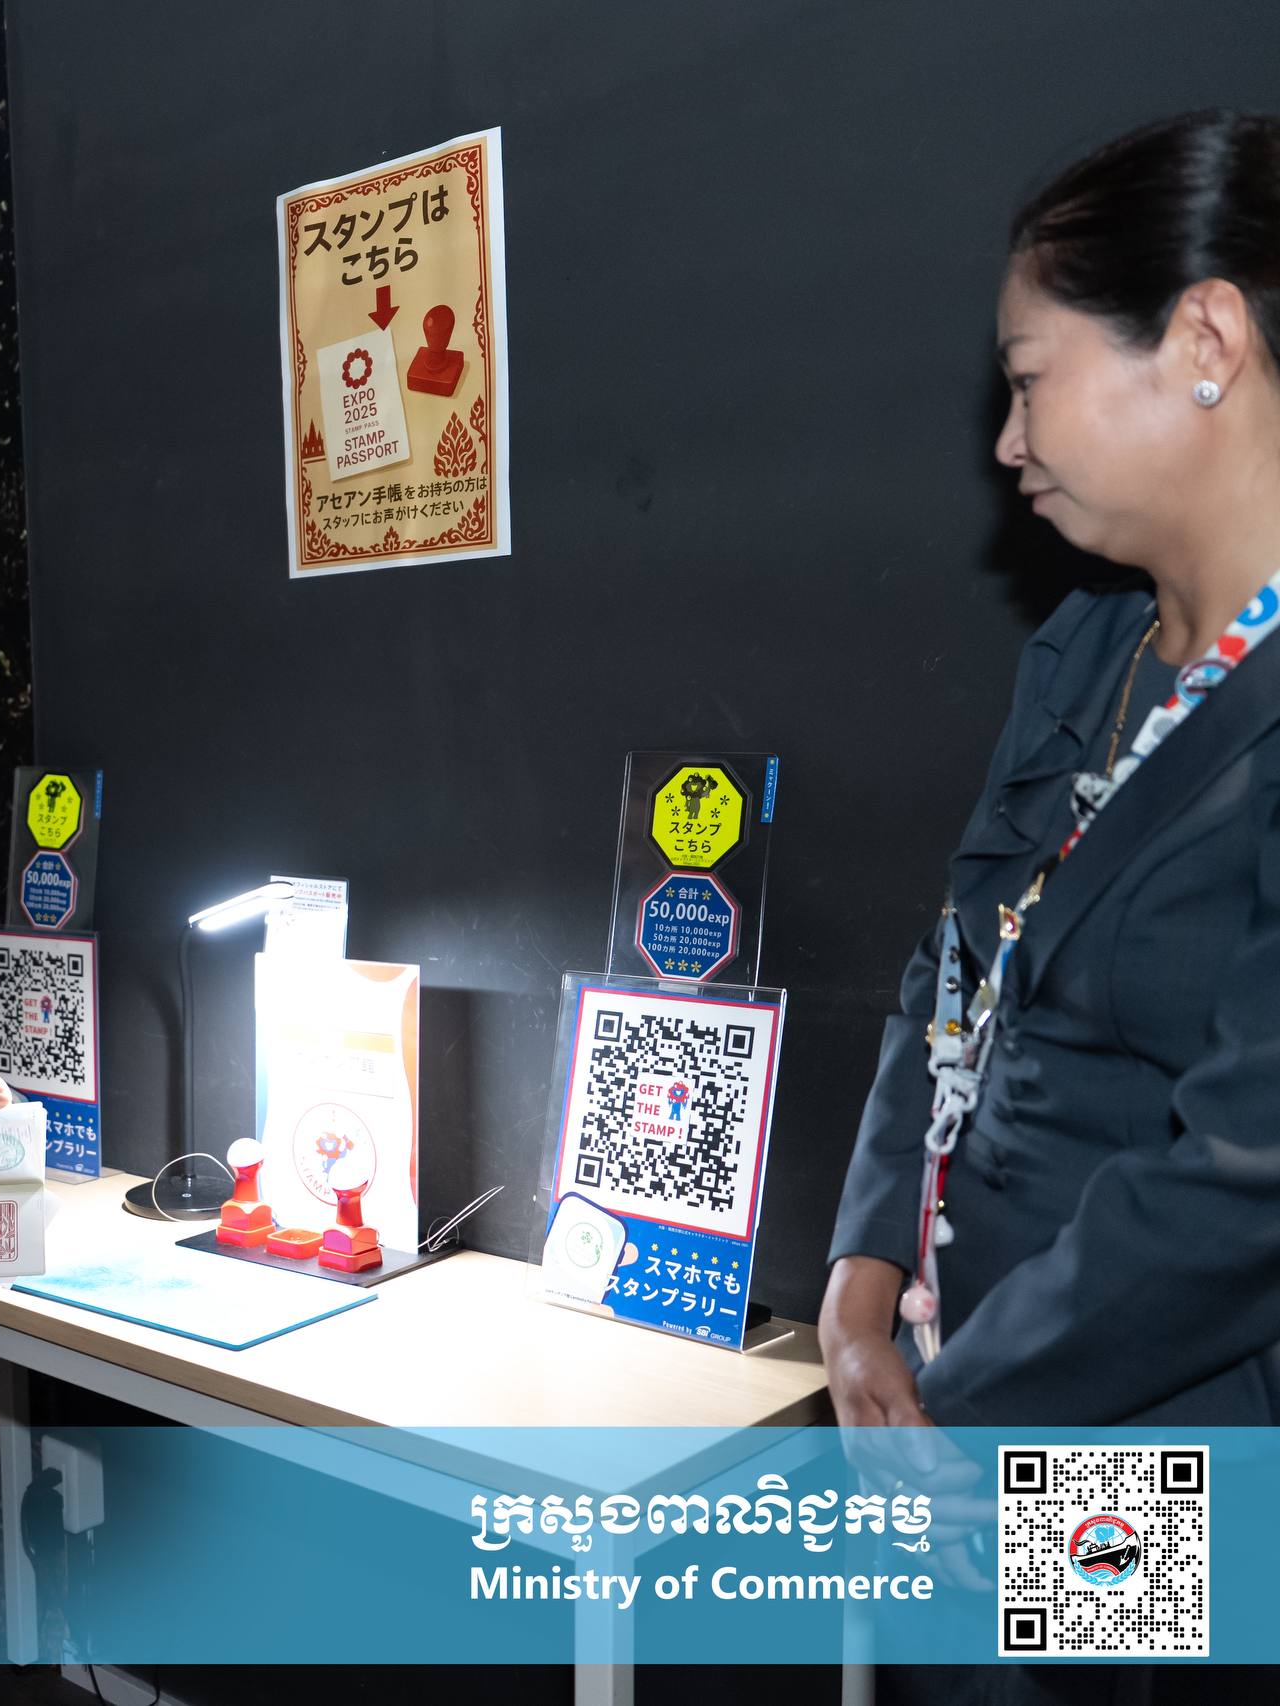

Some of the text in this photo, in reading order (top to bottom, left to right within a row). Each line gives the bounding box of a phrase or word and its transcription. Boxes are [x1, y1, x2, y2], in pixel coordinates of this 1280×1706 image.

[303, 184, 450, 257] スタンプは
[341, 237, 419, 286] こちら
[342, 387, 376, 409] EXPO
[344, 402, 378, 425] 2025
[344, 429, 386, 452] STAMP
[336, 440, 400, 470] PASSPORT
[316, 476, 488, 513] アセアン手帳をお持ちの方は
[322, 500, 465, 531] スタッフにお声がけください
[669, 821, 721, 837] スタンプ
[674, 839, 712, 853] こちら
[677, 887, 700, 900] 合計
[648, 901, 730, 926] 50,000exp
[679, 936, 721, 949] 20,000exp
[680, 926, 722, 938] 10,000exp
[678, 946, 720, 959] 20,000exp
[23, 1011, 38, 1021] THE
[639, 1083, 664, 1097] GET
[637, 1101, 661, 1116] THE
[644, 1255, 741, 1295] スマホでも
[604, 1274, 738, 1317] スタンプラリー
